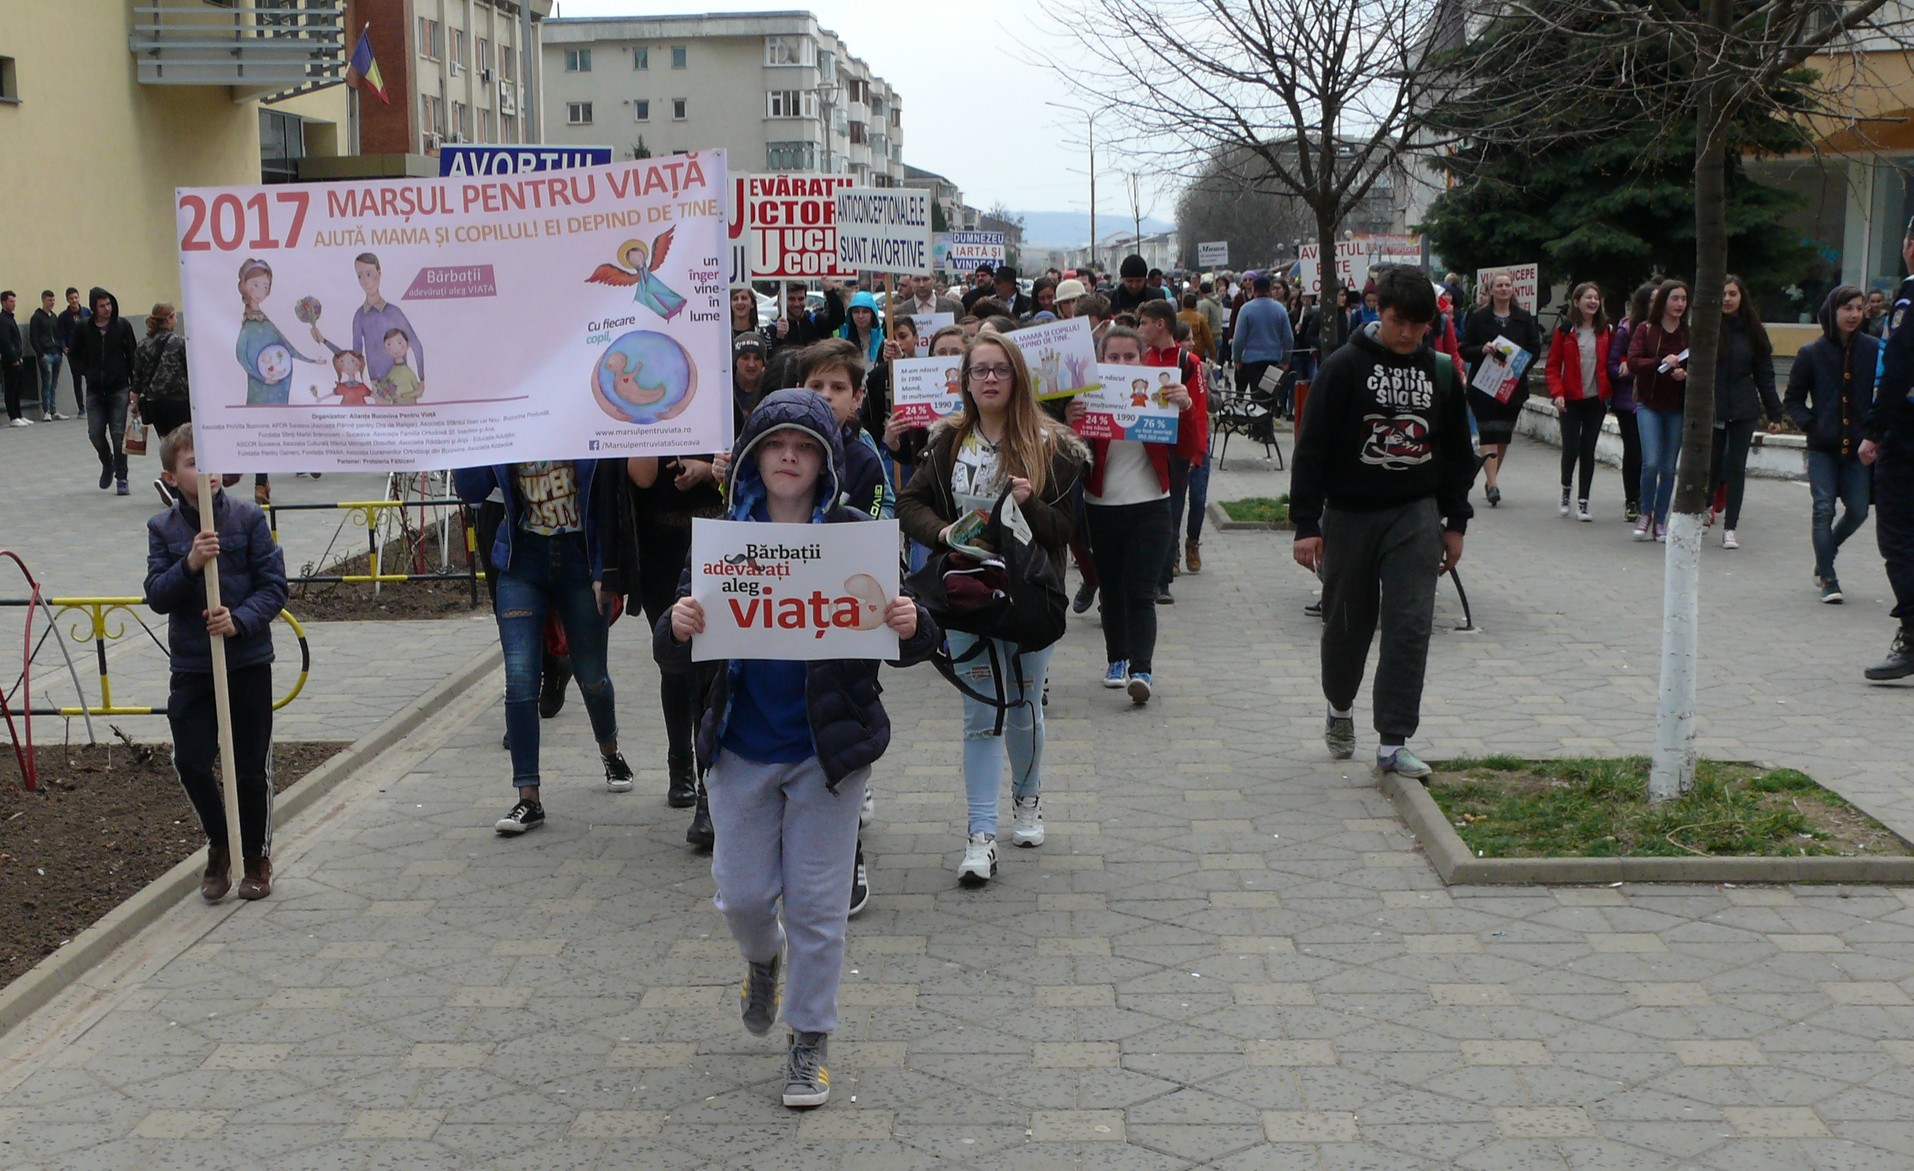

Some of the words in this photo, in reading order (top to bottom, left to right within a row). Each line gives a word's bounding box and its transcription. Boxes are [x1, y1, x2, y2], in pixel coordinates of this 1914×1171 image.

[179, 191, 310, 251] 2017
[327, 185, 454, 222] MARȘUL
[462, 174, 596, 213] PENTRU
[605, 152, 706, 199] VIAȚĂ
[314, 224, 366, 247] AJUTĂ
[371, 226, 431, 246] MAMA
[435, 226, 450, 247] ȘI
[455, 219, 538, 242] COPILUL!
[545, 218, 561, 236] EI
[567, 208, 641, 234] DEPIND
[647, 204, 673, 223] DE
[678, 198, 724, 219] TINE.
[953, 233, 1004, 244] DUMNEZEU
[840, 236, 867, 263] SUNT
[870, 237, 925, 268] AVORTIVE
[1301, 242, 1364, 260] AVTUL
[703, 257, 719, 266] un
[785, 252, 854, 275] COP
[1316, 260, 1351, 276] ETE
[427, 268, 481, 284] Bărbații
[688, 269, 719, 283] înger
[694, 281, 719, 294] vine
[709, 296, 720, 307] în
[690, 310, 720, 322] lume
[587, 321, 601, 333] Cu
[602, 315, 636, 330] fiecare
[586, 331, 612, 345] copil,
[1019, 332, 1043, 342] MAMA
[1373, 364, 1426, 380] Sorts
[905, 406, 917, 415] 24
[918, 406, 927, 415] %
[934, 401, 952, 409] 1990
[1089, 402, 1127, 410] mulțumesc!
[1085, 414, 1098, 425] 24
[1099, 415, 1109, 426] %
[1117, 413, 1136, 421] 1990
[1143, 418, 1155, 428] 76
[1156, 419, 1166, 429] %
[594, 427, 692, 437] www.marsulpentruviata.ro
[745, 544, 821, 564] Bărbații
[721, 578, 760, 597] aleg
[728, 586, 860, 639] viața
